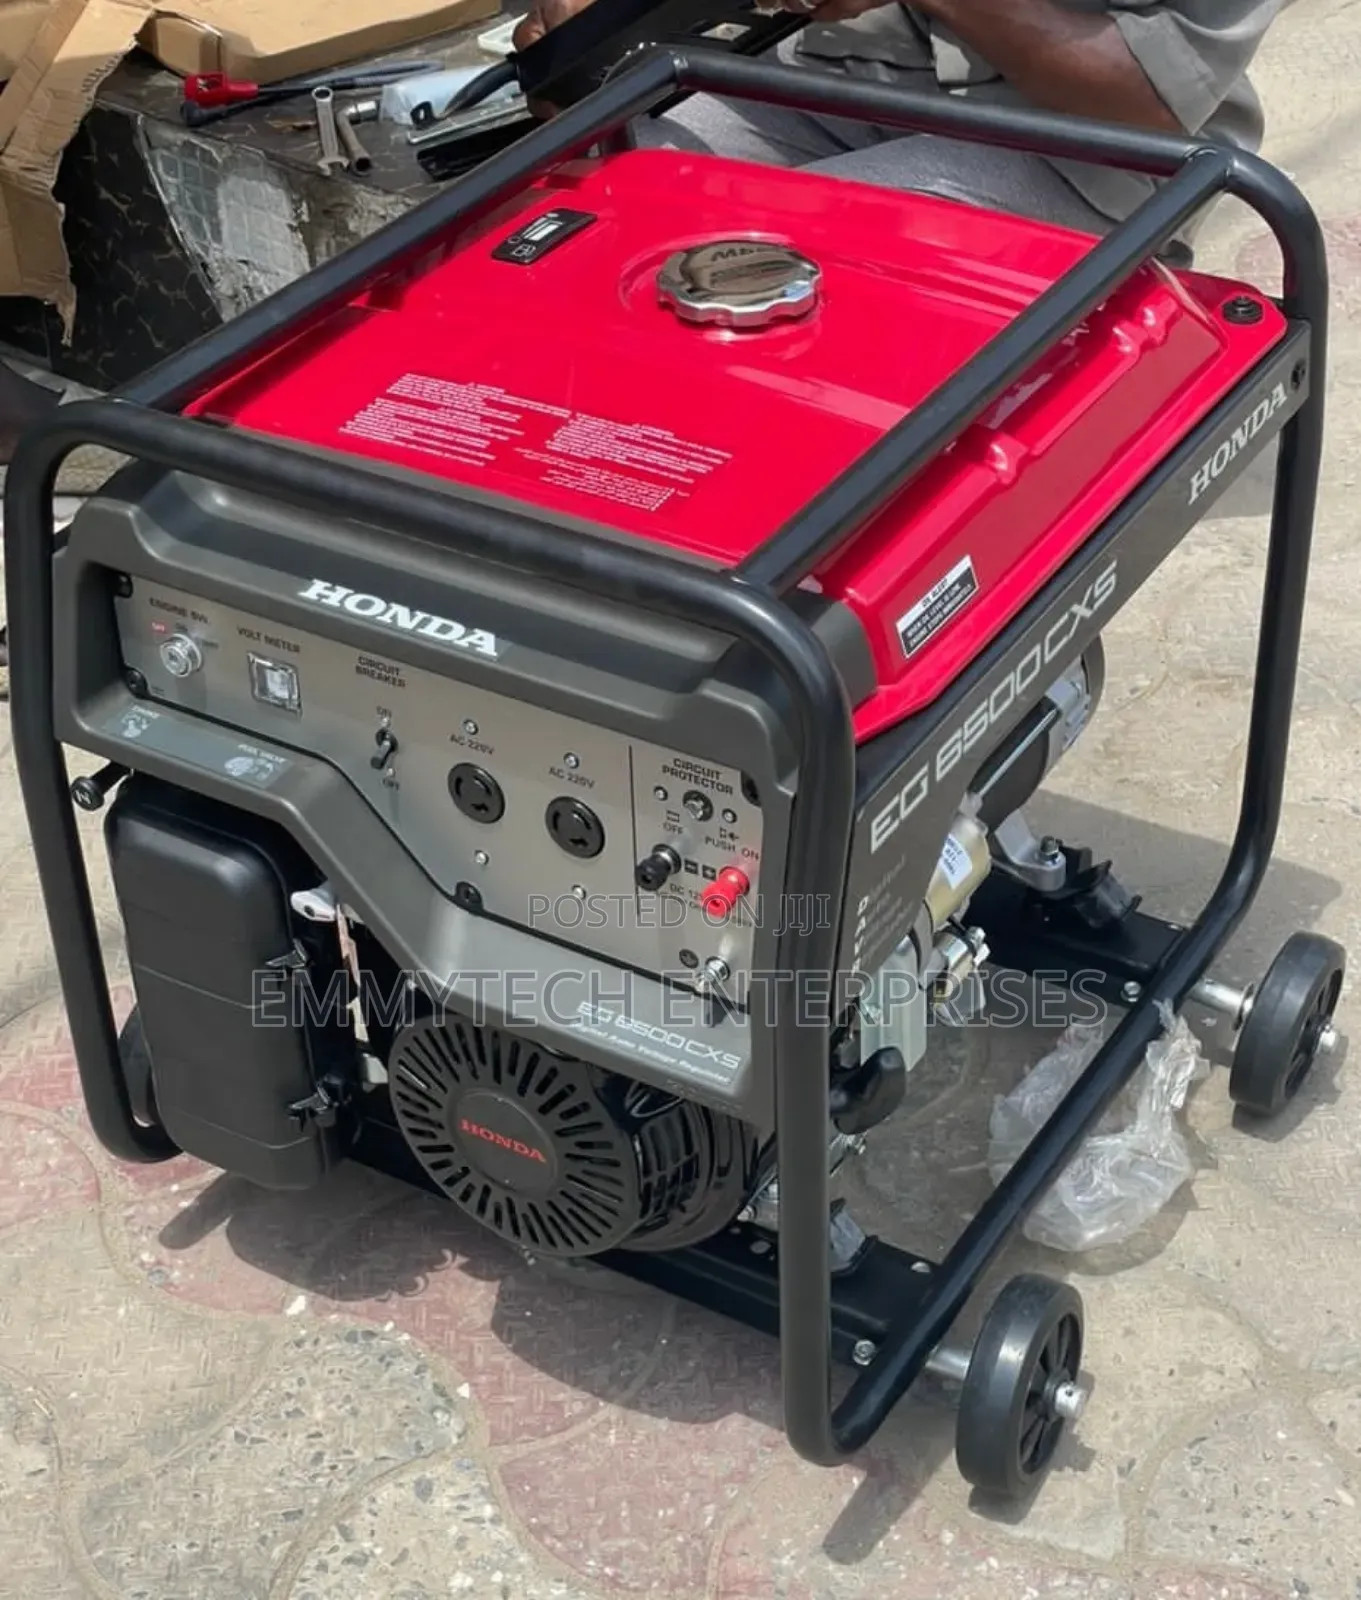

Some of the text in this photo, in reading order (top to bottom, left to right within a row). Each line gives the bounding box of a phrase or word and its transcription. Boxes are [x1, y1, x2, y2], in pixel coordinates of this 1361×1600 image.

[1188, 382, 1287, 504] HONDA
[298, 578, 498, 656] HONDA
[355, 665, 406, 688] BREAKER
[358, 656, 400, 676] CIRCUIT
[870, 763, 930, 854] EG
[936, 559, 1118, 783] 6500CXS
[450, 734, 466, 746] AC
[549, 766, 596, 789] AC 220V
[661, 764, 734, 796] PROTECTOR
[673, 757, 723, 781] CIRCUIT
[663, 822, 685, 836] OFF
[704, 835, 760, 861] PUSH ON
[459, 1118, 547, 1164] HONDA
